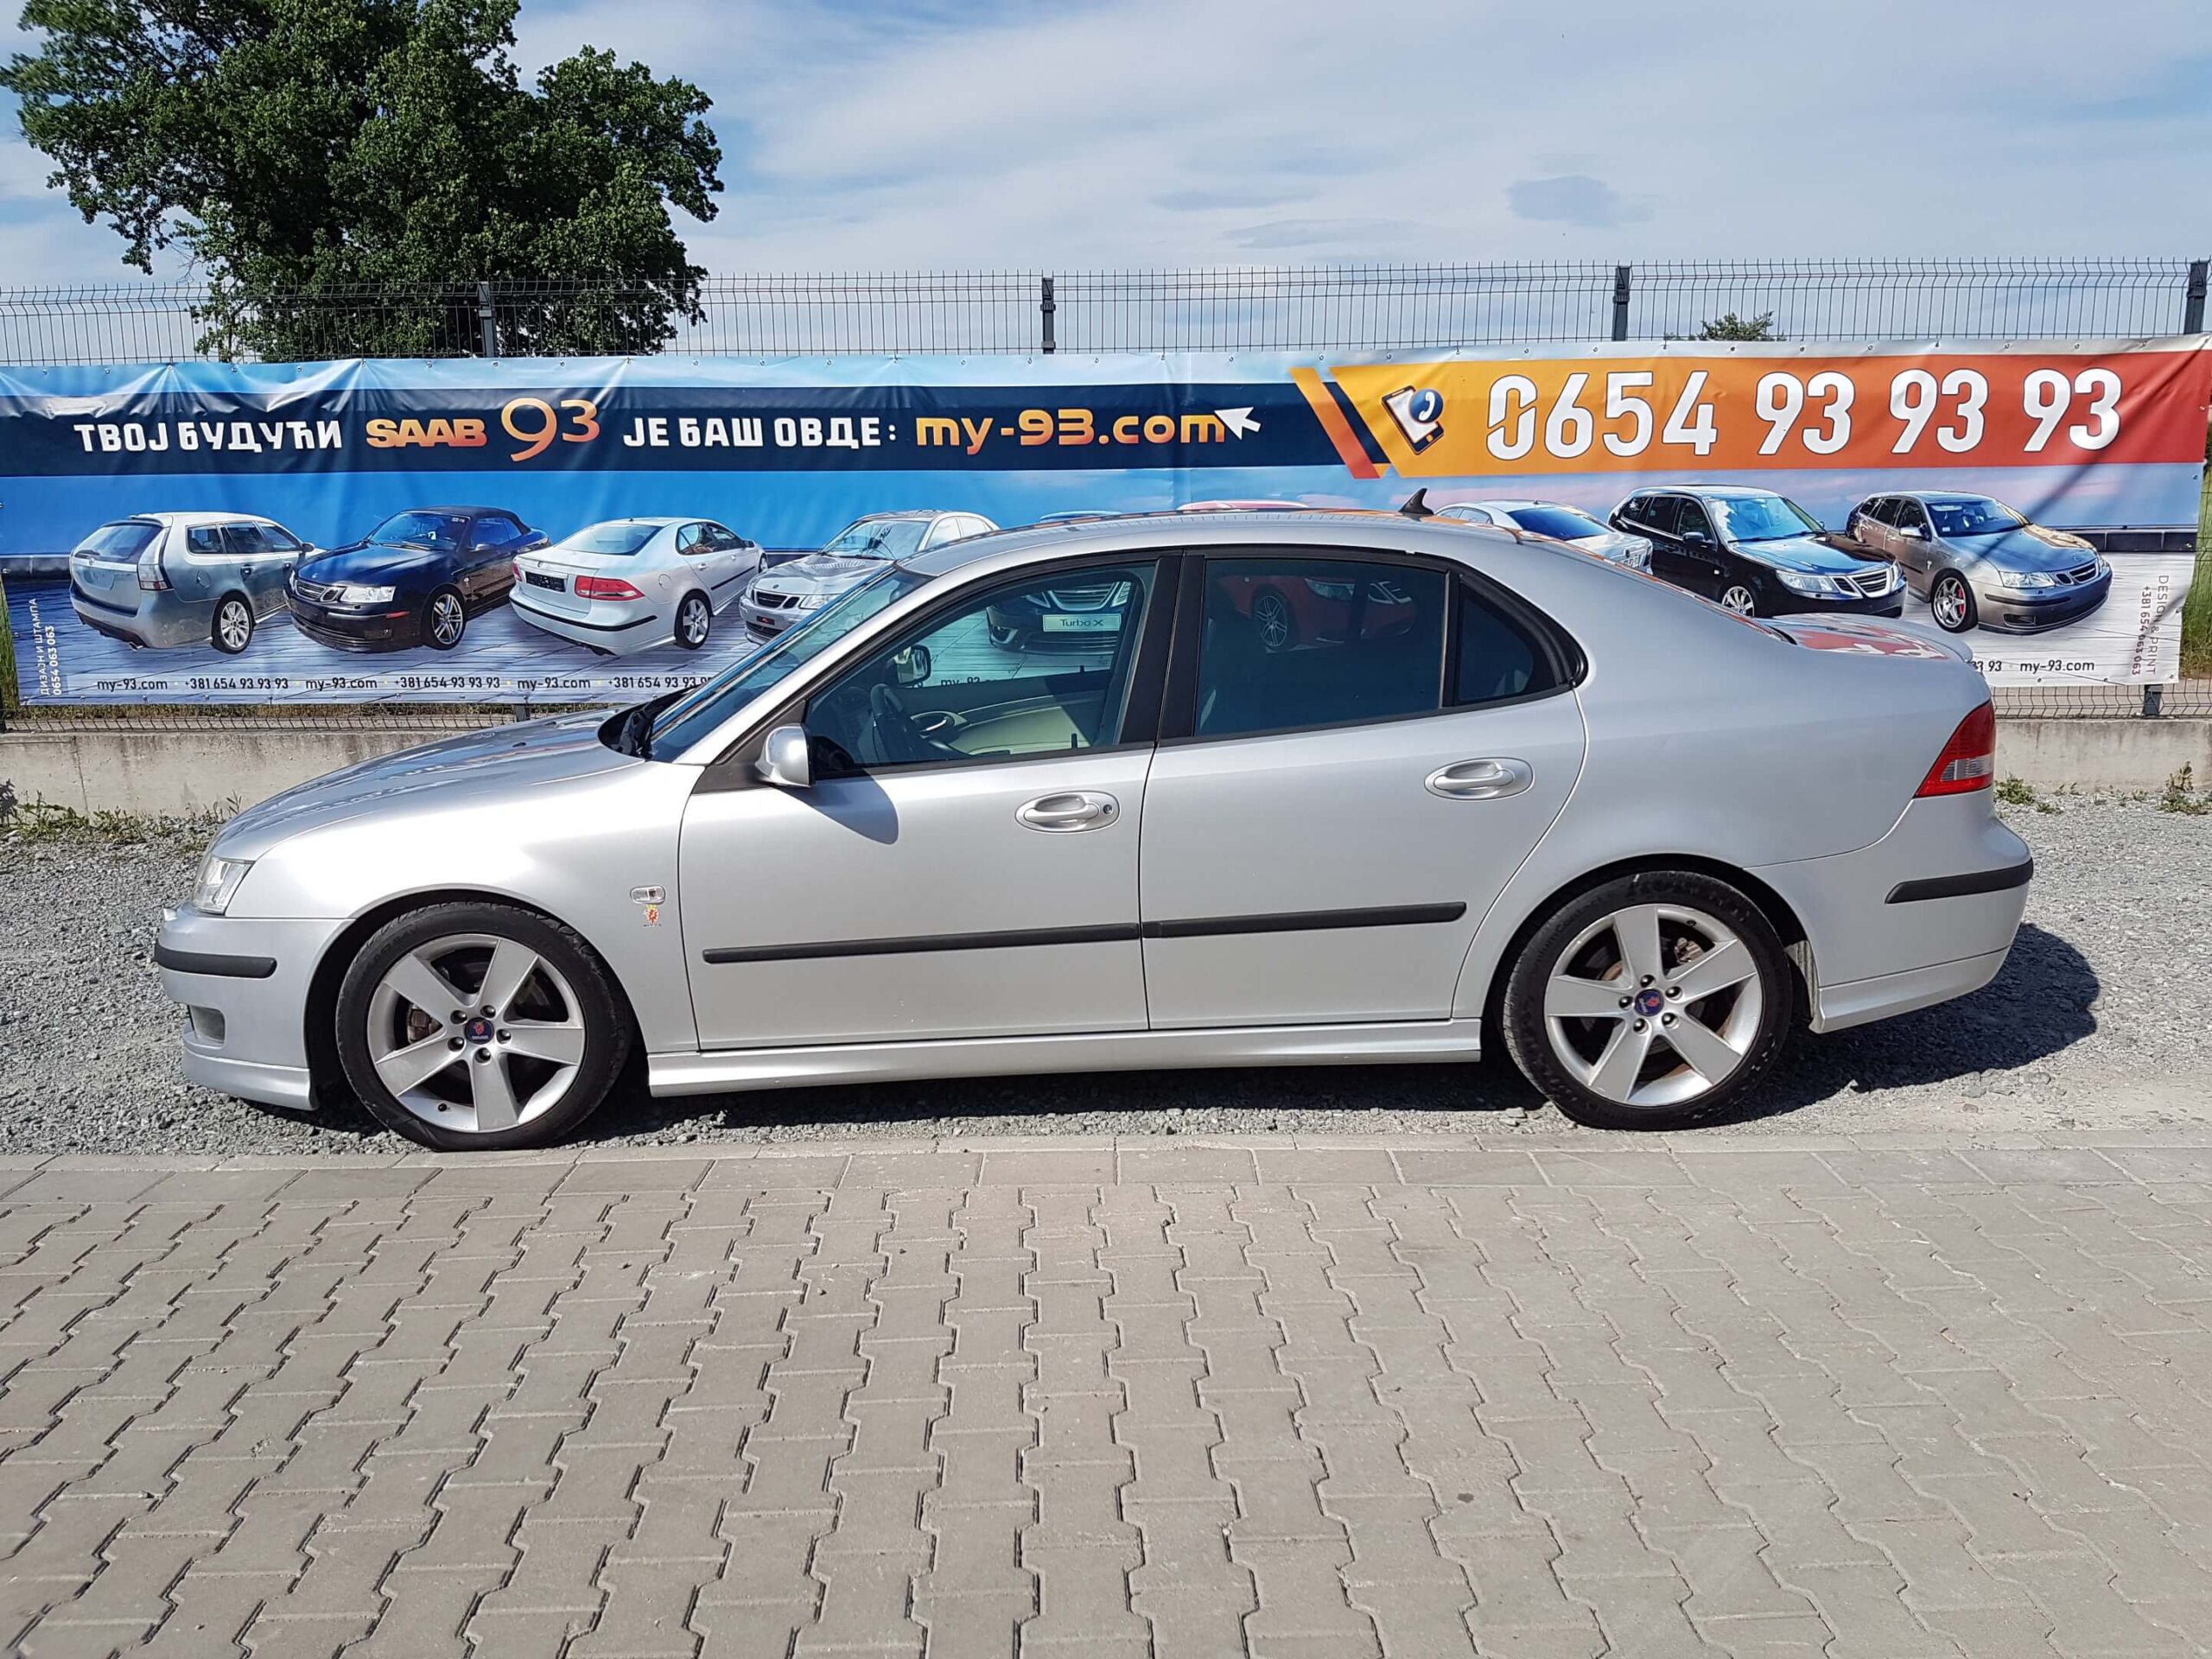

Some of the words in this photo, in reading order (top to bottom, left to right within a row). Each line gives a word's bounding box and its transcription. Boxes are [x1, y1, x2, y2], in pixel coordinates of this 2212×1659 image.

[1485, 370, 1718, 461] 0654
[1755, 371, 1855, 456] 93
[1889, 367, 1988, 454] 93
[2022, 367, 2122, 453] 93
[73, 423, 169, 453] ТВОЈ
[177, 420, 343, 454] БУДУЋИ
[365, 418, 487, 448] SAAB
[500, 397, 601, 462] 93
[622, 417, 670, 447] ЈЕ
[678, 417, 764, 447] БАШ
[915, 408, 1225, 455] my-93.com
[2141, 586, 2152, 608] +381
[2154, 575, 2169, 622] DESIGN
[29, 598, 42, 643] ШТАМПА
[2139, 612, 2150, 631] 654
[45, 626, 55, 645] 063
[2135, 634, 2145, 653] 063
[48, 648, 59, 666] 063
[1988, 660, 2002, 671] 93
[2019, 659, 2094, 674] my-93.com
[2132, 656, 2142, 675] 063
[2146, 637, 2158, 674] PRINT
[36, 656, 50, 696] ДИЗАЈН
[51, 669, 61, 696] 0654
[97, 677, 168, 692] my-93.com
[185, 677, 210, 689] +381
[213, 677, 236, 689] 654
[240, 677, 253, 689] 93
[258, 677, 271, 689] 93
[276, 677, 289, 689] 93
[305, 677, 377, 691] my-93.com
[395, 677, 420, 689] +381
[424, 677, 447, 689] 654
[451, 677, 464, 689] 93
[469, 677, 482, 689] 93
[486, 677, 499, 689] 93
[518, 677, 590, 691] my-93.com
[608, 677, 634, 688] +381
[638, 677, 661, 688] 654
[664, 677, 678, 688] 93
[683, 677, 696, 688] 93
